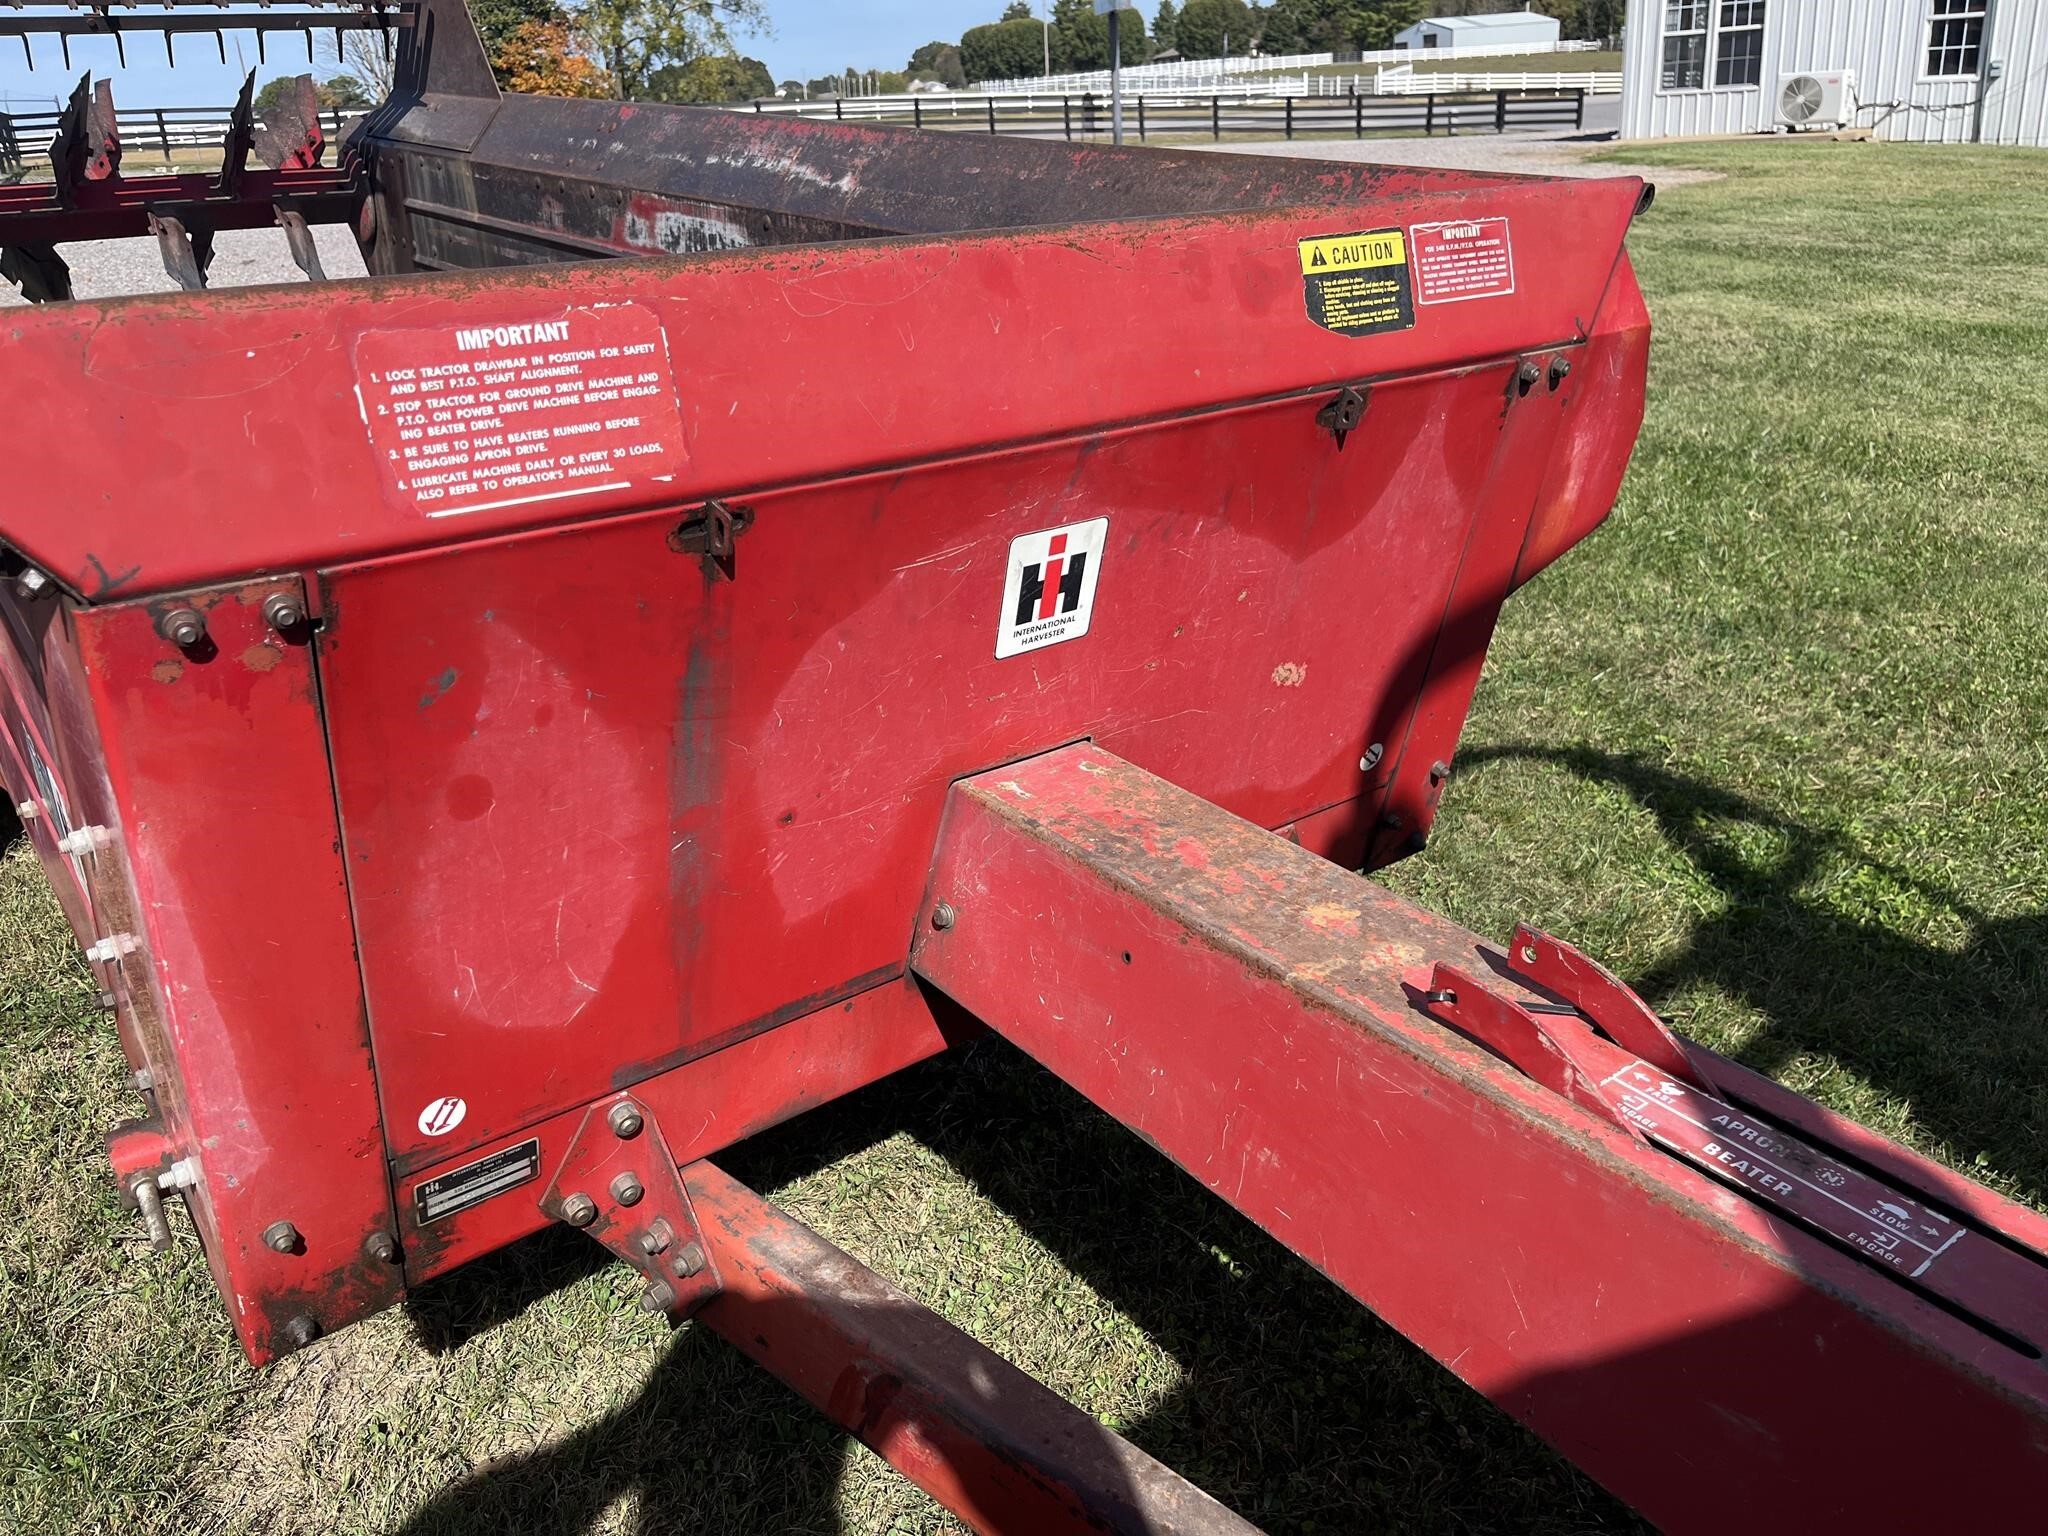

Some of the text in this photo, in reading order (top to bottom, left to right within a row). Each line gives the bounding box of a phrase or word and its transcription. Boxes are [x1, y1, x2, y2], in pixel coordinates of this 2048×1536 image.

[1442, 226, 1480, 240] IMPORTANT
[1333, 241, 1393, 264] CAUTION
[456, 321, 569, 350] IMPORTANT
[370, 343, 655, 383] 1. LOCK TRACTOR DRAWBAR IN POSITION FOR SAFETY
[378, 372, 658, 415] 2. STOP TRACTOR FOR GROUND DRIVE MACHINE AND
[390, 364, 582, 395] AND BEST P.T.O. SHAFT ALIGNMENT.
[397, 385, 661, 426] P.T.O. ON POWER DRIVE MACHINE BEFORE ENGAG-
[389, 417, 640, 460] 3. BE SURE TO HAVE BEATERS RUNNING BEFORE
[400, 418, 504, 440] ING BEATER DRIVE.
[398, 442, 664, 490] 4. LUBRICATE MACHINE DAILY OR EVERY 30 LOADS,
[408, 442, 548, 471] ENGAGING APRON DRIVE.
[416, 463, 614, 501] ALSO REFER TO OPERATOR'S MANUAL.
[1013, 616, 1076, 638] INTERNATIONAL
[1021, 628, 1065, 646] HARVESTER
[1645, 1087, 1676, 1104] FAST
[1712, 1114, 1790, 1158] APRON
[1702, 1142, 1792, 1196] BEATER
[1870, 1208, 1910, 1231] SLOW
[1847, 1232, 1903, 1265] ENGAGE
